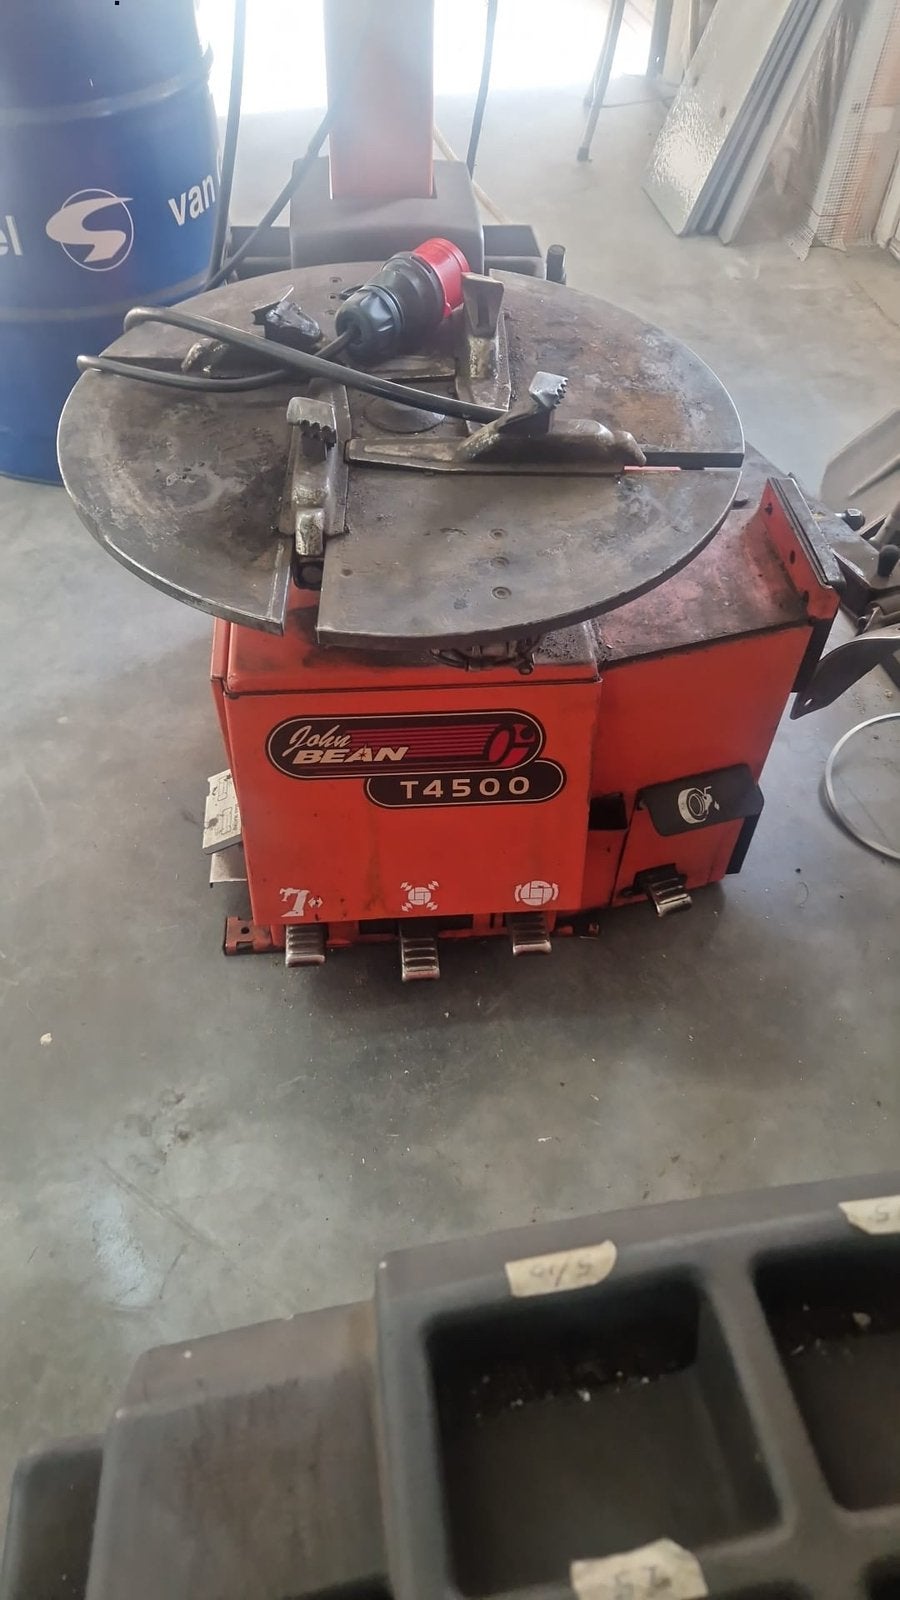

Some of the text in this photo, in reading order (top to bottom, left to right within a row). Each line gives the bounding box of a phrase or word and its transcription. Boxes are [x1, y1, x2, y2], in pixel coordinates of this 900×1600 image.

[168, 174, 216, 226] van
[282, 724, 351, 757] John
[292, 746, 409, 765] BEAN
[400, 776, 530, 799] T4500
